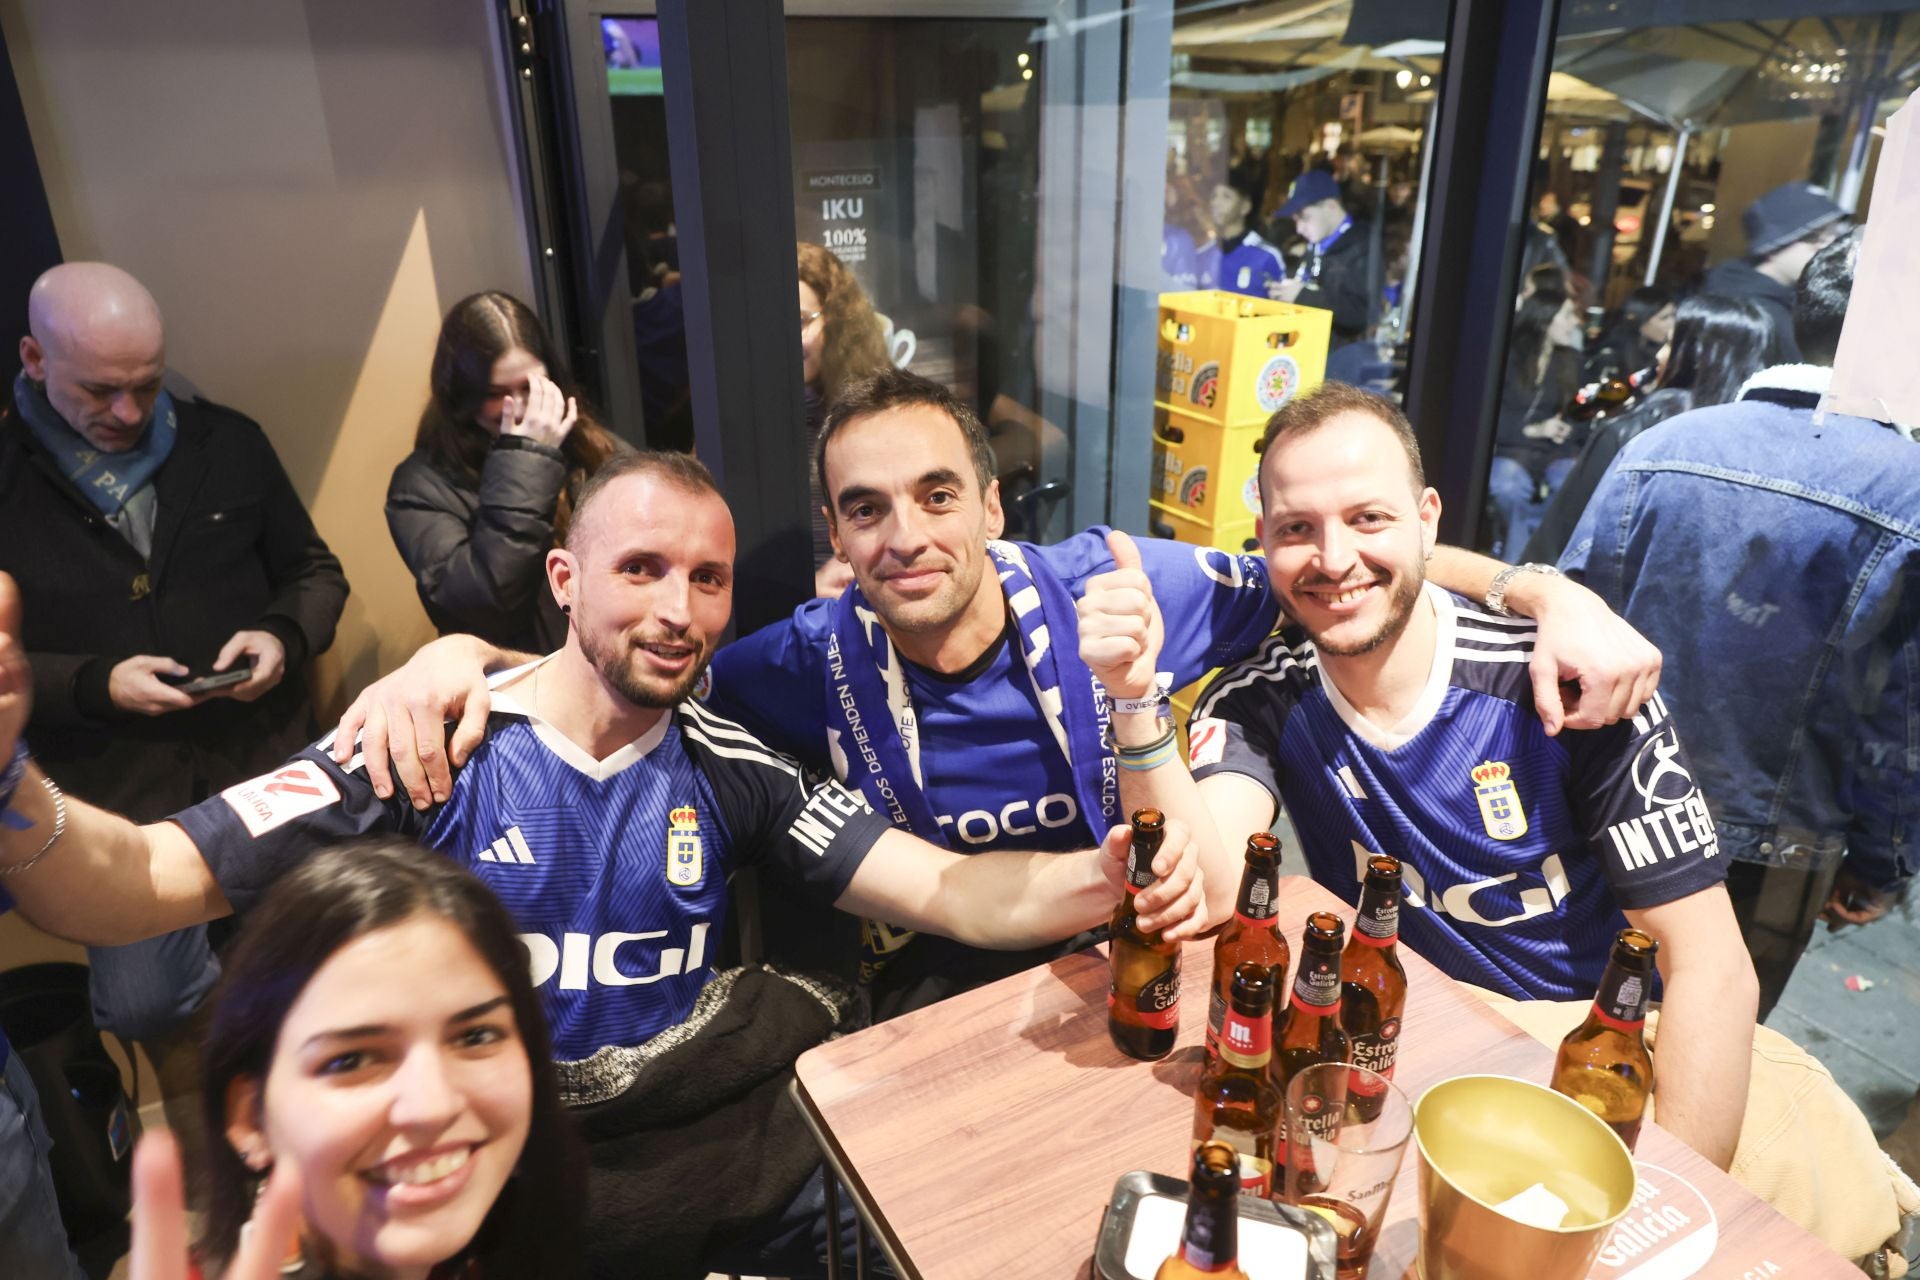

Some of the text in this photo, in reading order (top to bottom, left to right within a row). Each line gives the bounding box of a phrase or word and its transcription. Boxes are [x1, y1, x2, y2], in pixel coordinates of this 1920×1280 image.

[822, 198, 864, 220] IKU
[823, 228, 867, 247] 100%
[837, 685, 882, 774] DEFIENDEN
[1607, 788, 1715, 871] INTEG
